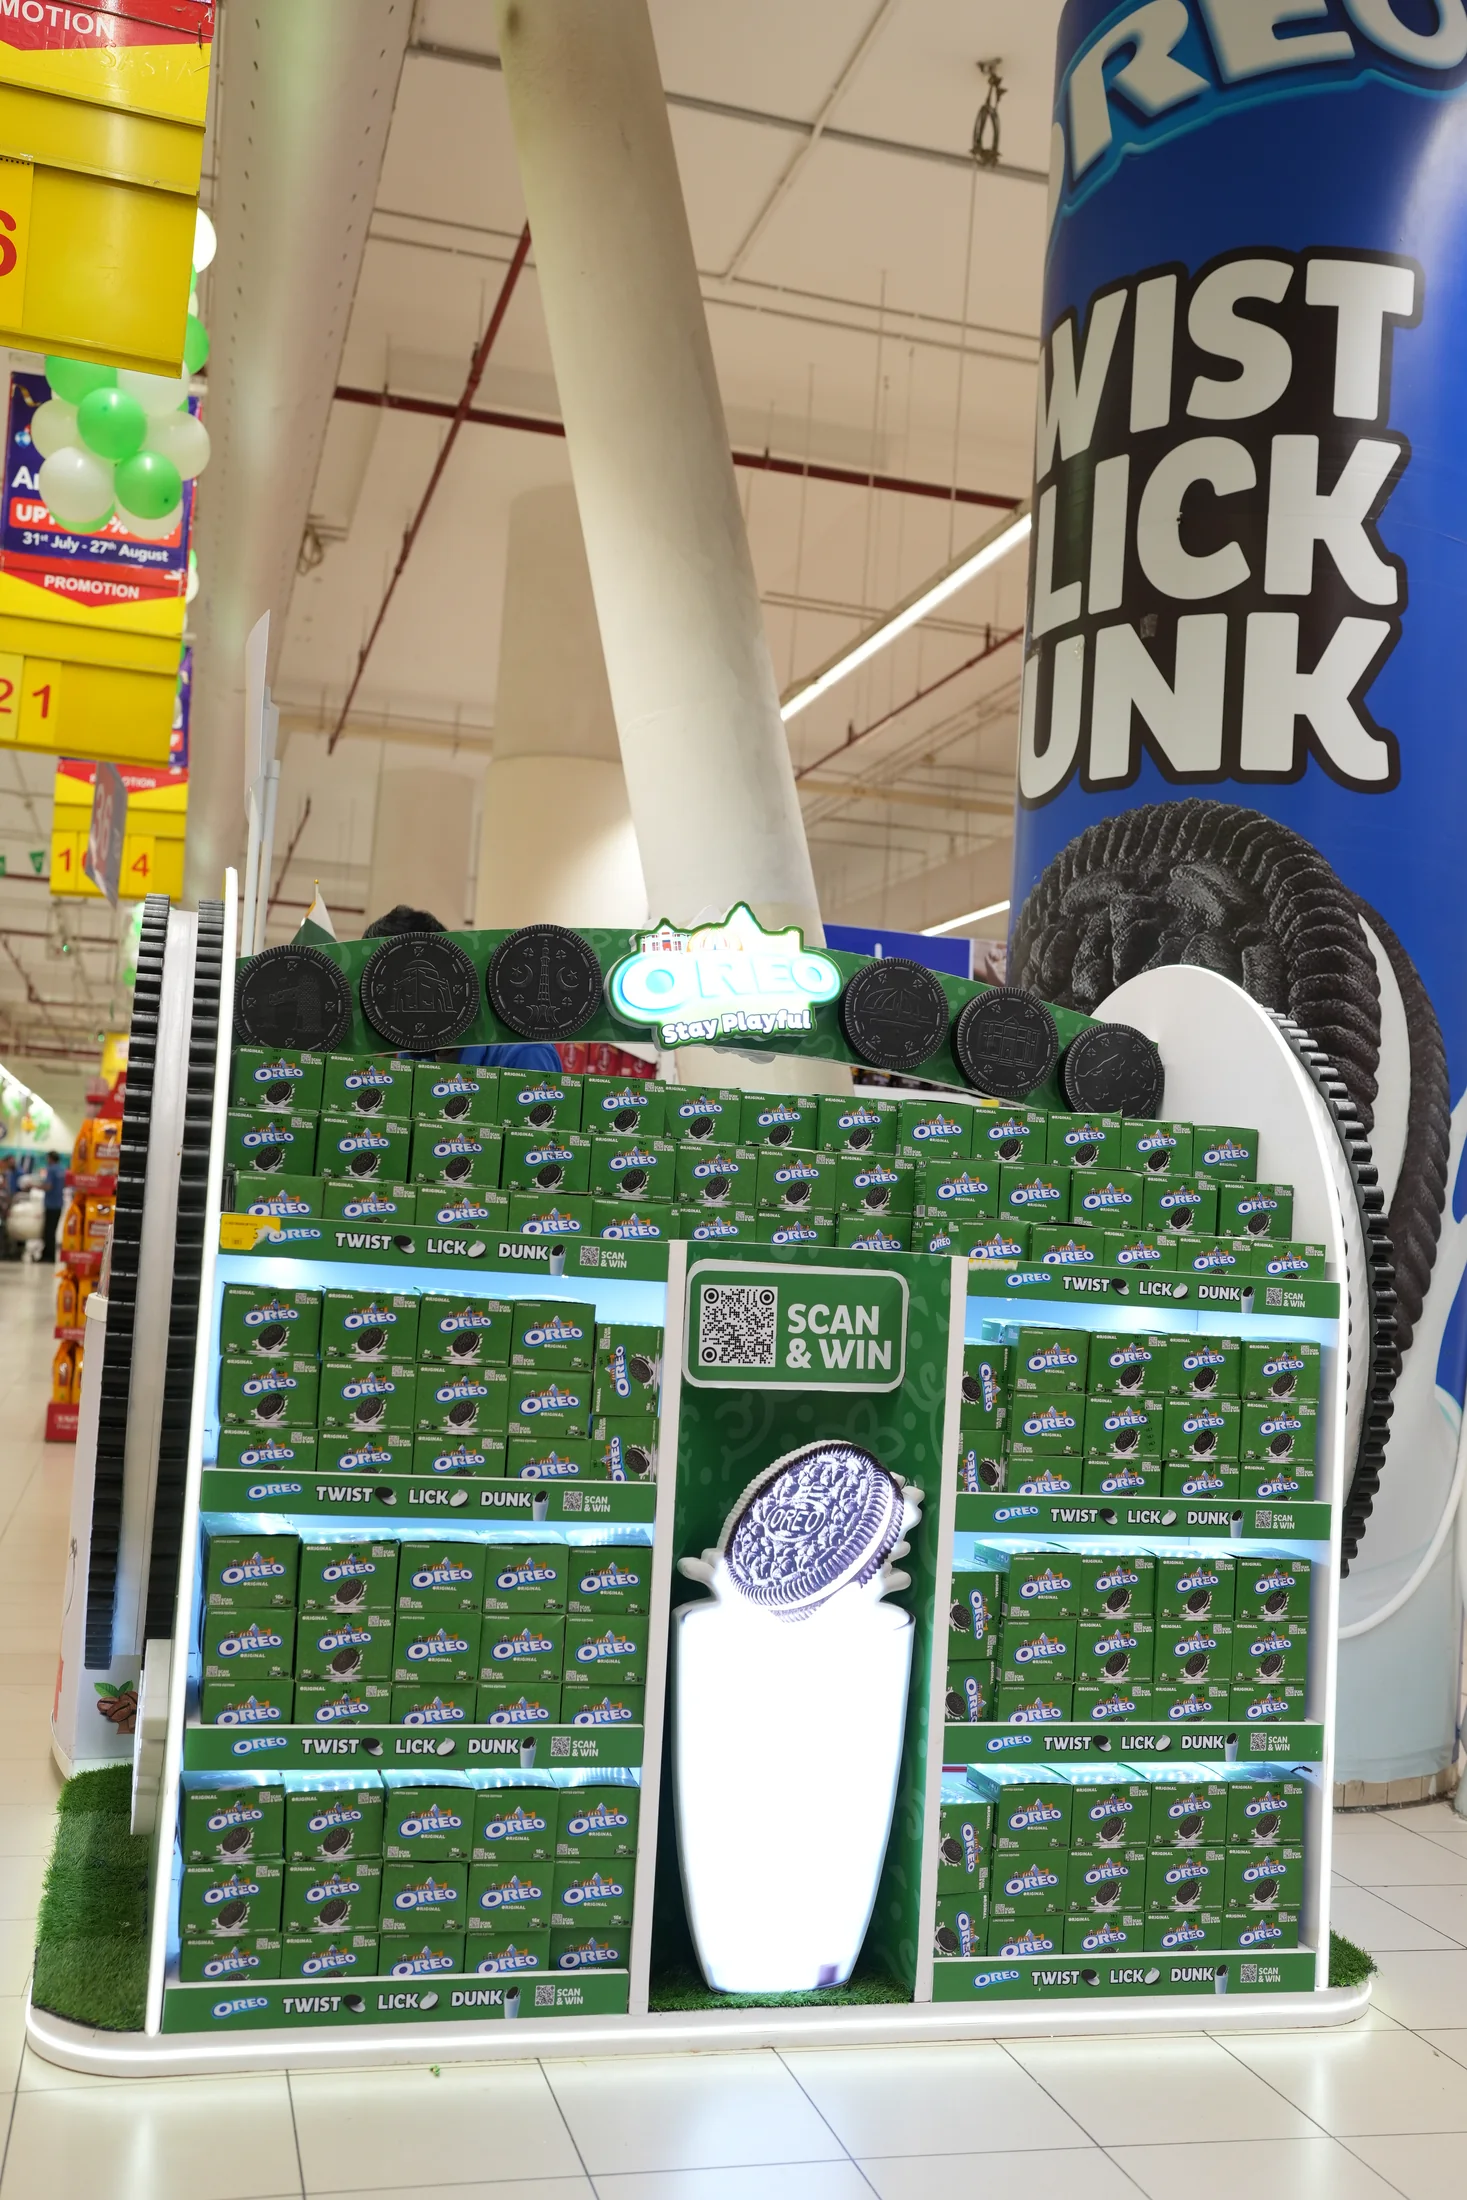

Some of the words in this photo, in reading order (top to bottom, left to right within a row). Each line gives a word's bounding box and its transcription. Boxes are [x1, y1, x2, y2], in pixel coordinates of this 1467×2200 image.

[1031, 435, 1402, 639] LICK
[51, 535, 80, 554] July
[118, 544, 169, 562] August
[44, 575, 139, 599] PROMOTION
[622, 951, 837, 1010] OREO
[662, 1019, 719, 1044] Stay
[721, 1009, 812, 1035] Playful
[254, 1067, 304, 1081] OREO
[345, 1074, 393, 1088] OREO
[432, 1081, 480, 1096] OREO
[518, 1089, 564, 1104] OREO
[602, 1095, 648, 1109] OREO
[679, 1102, 723, 1117] OREO
[243, 1131, 294, 1146] OREO
[912, 1122, 962, 1140] OREO
[988, 1124, 1030, 1139] OREO
[1065, 1129, 1106, 1145] OREO
[339, 1136, 389, 1152] OREO
[610, 1154, 657, 1170] OREO
[1203, 1147, 1249, 1164] OREO
[775, 1166, 819, 1182] OREO
[937, 1180, 989, 1199] OREO
[344, 1201, 396, 1217] OREO
[1083, 1192, 1133, 1209] OREO
[1160, 1193, 1202, 1208] OREO
[1237, 1198, 1278, 1214] OREO
[437, 1206, 489, 1223] OREO
[268, 1229, 321, 1243] OREO
[335, 1232, 392, 1251] TWIST
[427, 1238, 468, 1256] LICK
[498, 1242, 550, 1262] DUNK
[929, 1237, 951, 1253] OREO
[601, 1250, 625, 1260] SCAN
[1117, 1247, 1161, 1264] OREO
[608, 1259, 627, 1269] WIN
[1007, 1273, 1052, 1287] OREO
[1063, 1276, 1110, 1292] TWIST
[1139, 1281, 1173, 1297] LICK
[1198, 1285, 1240, 1300] DUNK
[1283, 1292, 1304, 1300] SCAN
[1289, 1299, 1306, 1308] WIN
[245, 1308, 298, 1325] OREO
[344, 1312, 397, 1328] OREO
[786, 1303, 880, 1336] SCAN
[524, 1326, 583, 1345] OREO
[785, 1337, 812, 1370] &
[818, 1338, 892, 1370] WIN
[1028, 1352, 1078, 1370] OREO
[1109, 1350, 1152, 1366] OREO
[617, 1345, 631, 1398] OREO
[1262, 1359, 1304, 1375] OREO
[243, 1377, 297, 1394] OREO
[436, 1384, 488, 1402] OREO
[980, 1363, 993, 1412] OREO
[1183, 1415, 1225, 1432] OREO
[248, 1483, 302, 1499] OREO
[316, 1486, 373, 1503] TWIST
[408, 1489, 449, 1506] LICK
[481, 1491, 532, 1508] DUNK
[584, 1495, 608, 1504] SCAN
[592, 1504, 611, 1513] WIN
[994, 1506, 1039, 1521] OREO
[1050, 1508, 1098, 1523] TWIST
[1127, 1509, 1162, 1524] LICK
[1187, 1511, 1229, 1526] DUNK
[768, 1508, 822, 1532] OREO
[1273, 1514, 1293, 1522] SCAN
[1278, 1521, 1295, 1530] WIN
[222, 1563, 285, 1584] OREO
[323, 1562, 376, 1581] OREO
[412, 1568, 473, 1588] OREO
[580, 1572, 639, 1592] OREO
[1020, 1578, 1071, 1597] OREO
[1096, 1573, 1139, 1590] OREO
[1176, 1573, 1219, 1592] OREO
[970, 1590, 983, 1640] OREO
[219, 1634, 282, 1656] OREO
[577, 1641, 636, 1661] OREO
[1015, 1642, 1066, 1662] OREO
[233, 1737, 287, 1754] OREO
[302, 1738, 360, 1754] TWIST
[395, 1738, 436, 1755] LICK
[468, 1738, 519, 1754] DUNK
[572, 1740, 597, 1749] SCAN
[987, 1735, 1032, 1751] OREO
[1044, 1735, 1092, 1751] TWIST
[1120, 1735, 1155, 1750] LICK
[1181, 1734, 1224, 1750] DUNK
[1268, 1736, 1288, 1744] SCAN
[1273, 1743, 1290, 1752] WIN
[579, 1748, 599, 1757] WIN
[1169, 1799, 1211, 1817] OREO
[1245, 1797, 1288, 1816] OREO
[208, 1809, 263, 1830] OREO
[400, 1816, 462, 1836] OREO
[568, 1812, 628, 1834] OREO
[1010, 1808, 1062, 1829] OREO
[306, 1881, 360, 1902] OREO
[395, 1888, 457, 1908] OREO
[974, 1970, 1020, 1987] OREO
[1032, 1970, 1080, 1986] TWIST
[1110, 1968, 1145, 1985] LICK
[1170, 1966, 1214, 1982] DUNK
[1258, 1967, 1278, 1975] SCAN
[1264, 1974, 1281, 1983] WIN
[557, 1987, 581, 1996] SCAN
[564, 1995, 583, 2005] WIN
[213, 1997, 268, 2017] OREO
[283, 1996, 341, 2014] TWIST
[377, 1993, 420, 2011] LICK
[451, 1989, 502, 2007] DUNK
